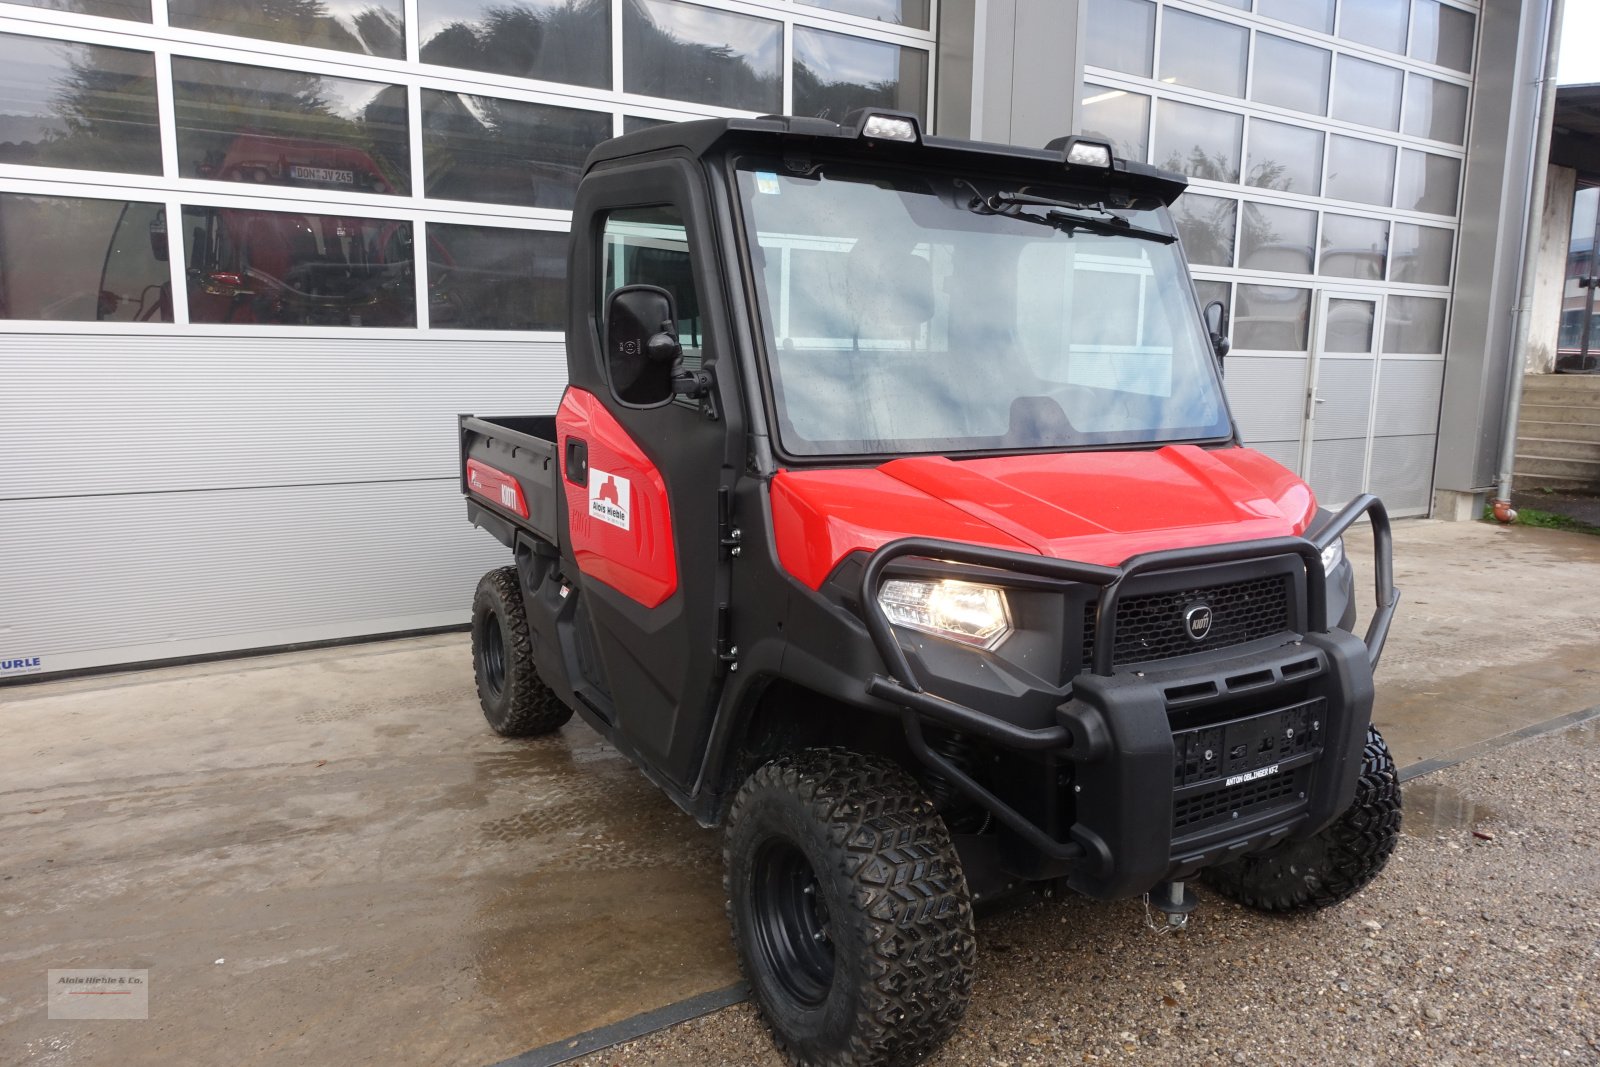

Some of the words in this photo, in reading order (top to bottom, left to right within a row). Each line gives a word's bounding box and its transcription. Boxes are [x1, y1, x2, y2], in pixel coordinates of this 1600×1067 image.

[297, 167, 315, 178] DON
[322, 170, 333, 180] JV
[335, 172, 352, 182] 245
[592, 501, 606, 513] Alois
[607, 506, 625, 521] Hieble
[0, 658, 40, 669] URLE
[1226, 775, 1243, 787] ANTON
[1268, 765, 1279, 775] KFZ
